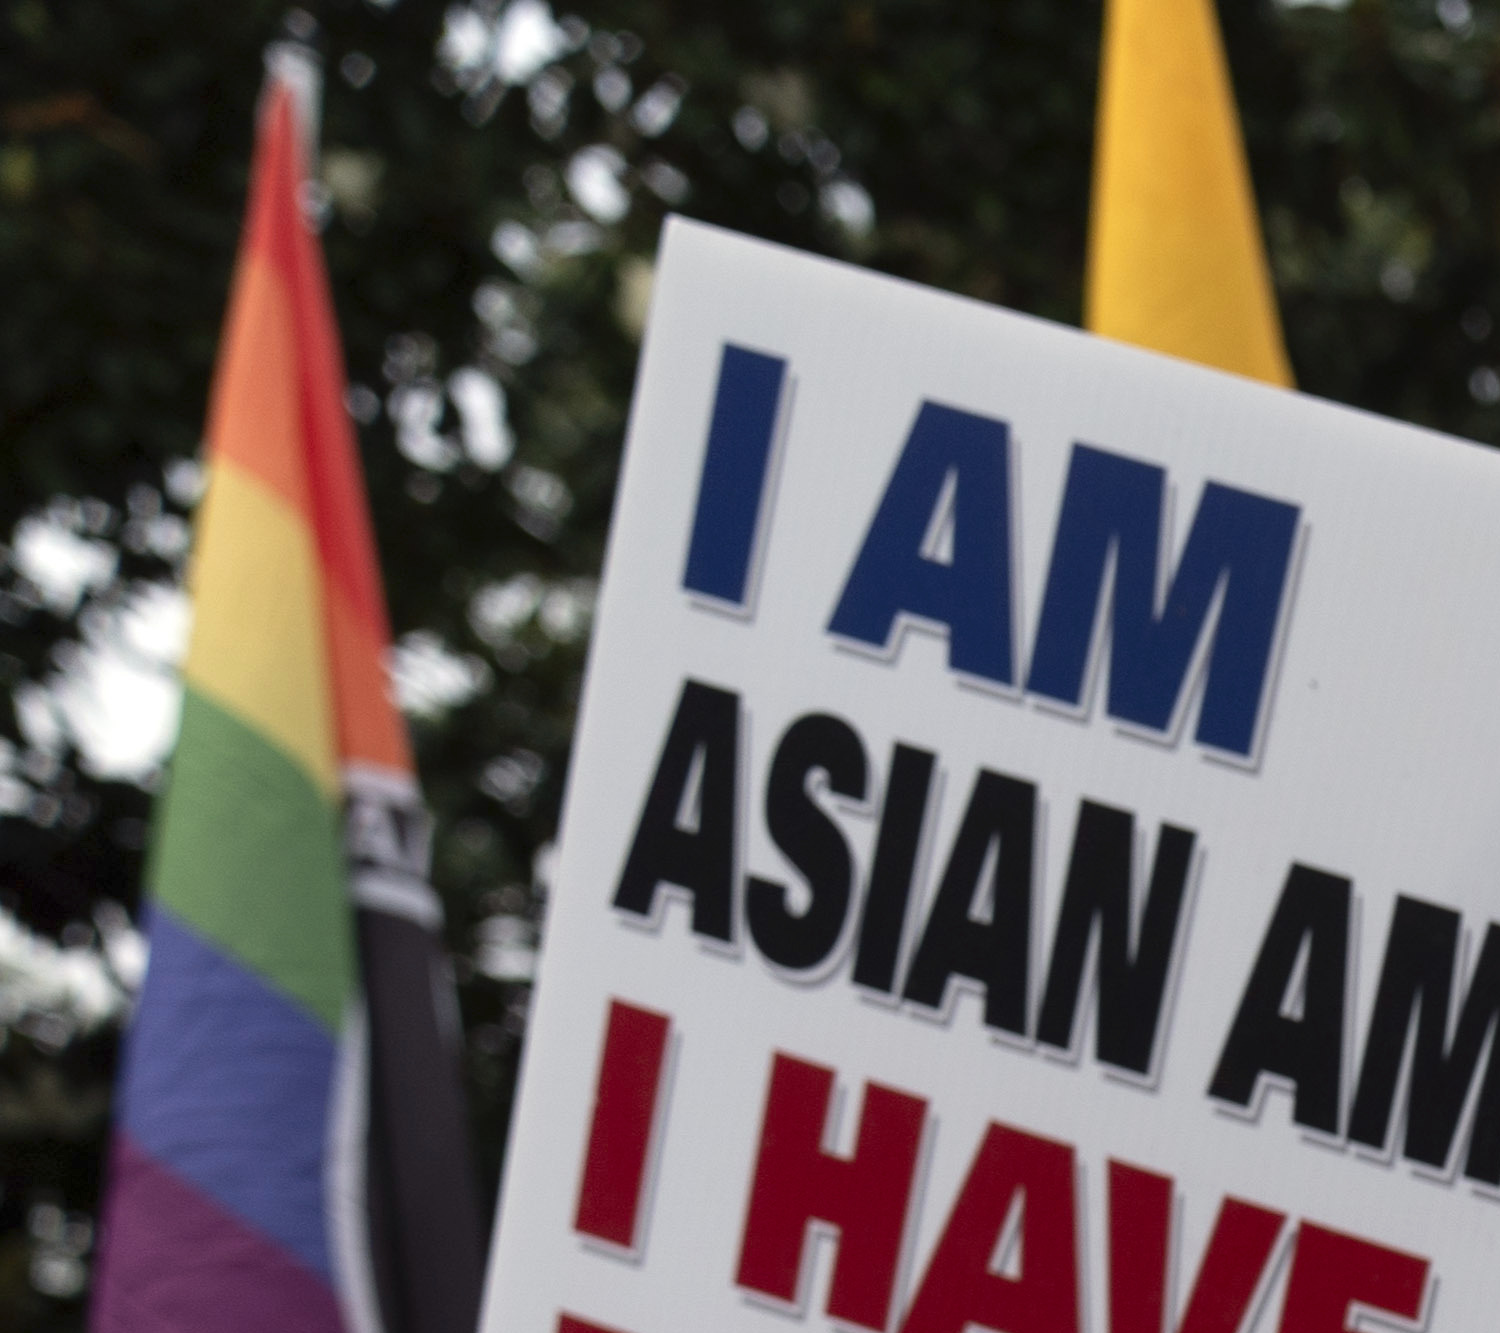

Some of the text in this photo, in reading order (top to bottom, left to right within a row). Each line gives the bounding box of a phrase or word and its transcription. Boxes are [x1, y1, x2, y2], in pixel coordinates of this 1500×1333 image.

[686, 347, 1300, 757] I AM
[615, 682, 1196, 1076] ASIAN
[576, 1003, 668, 1247] I
